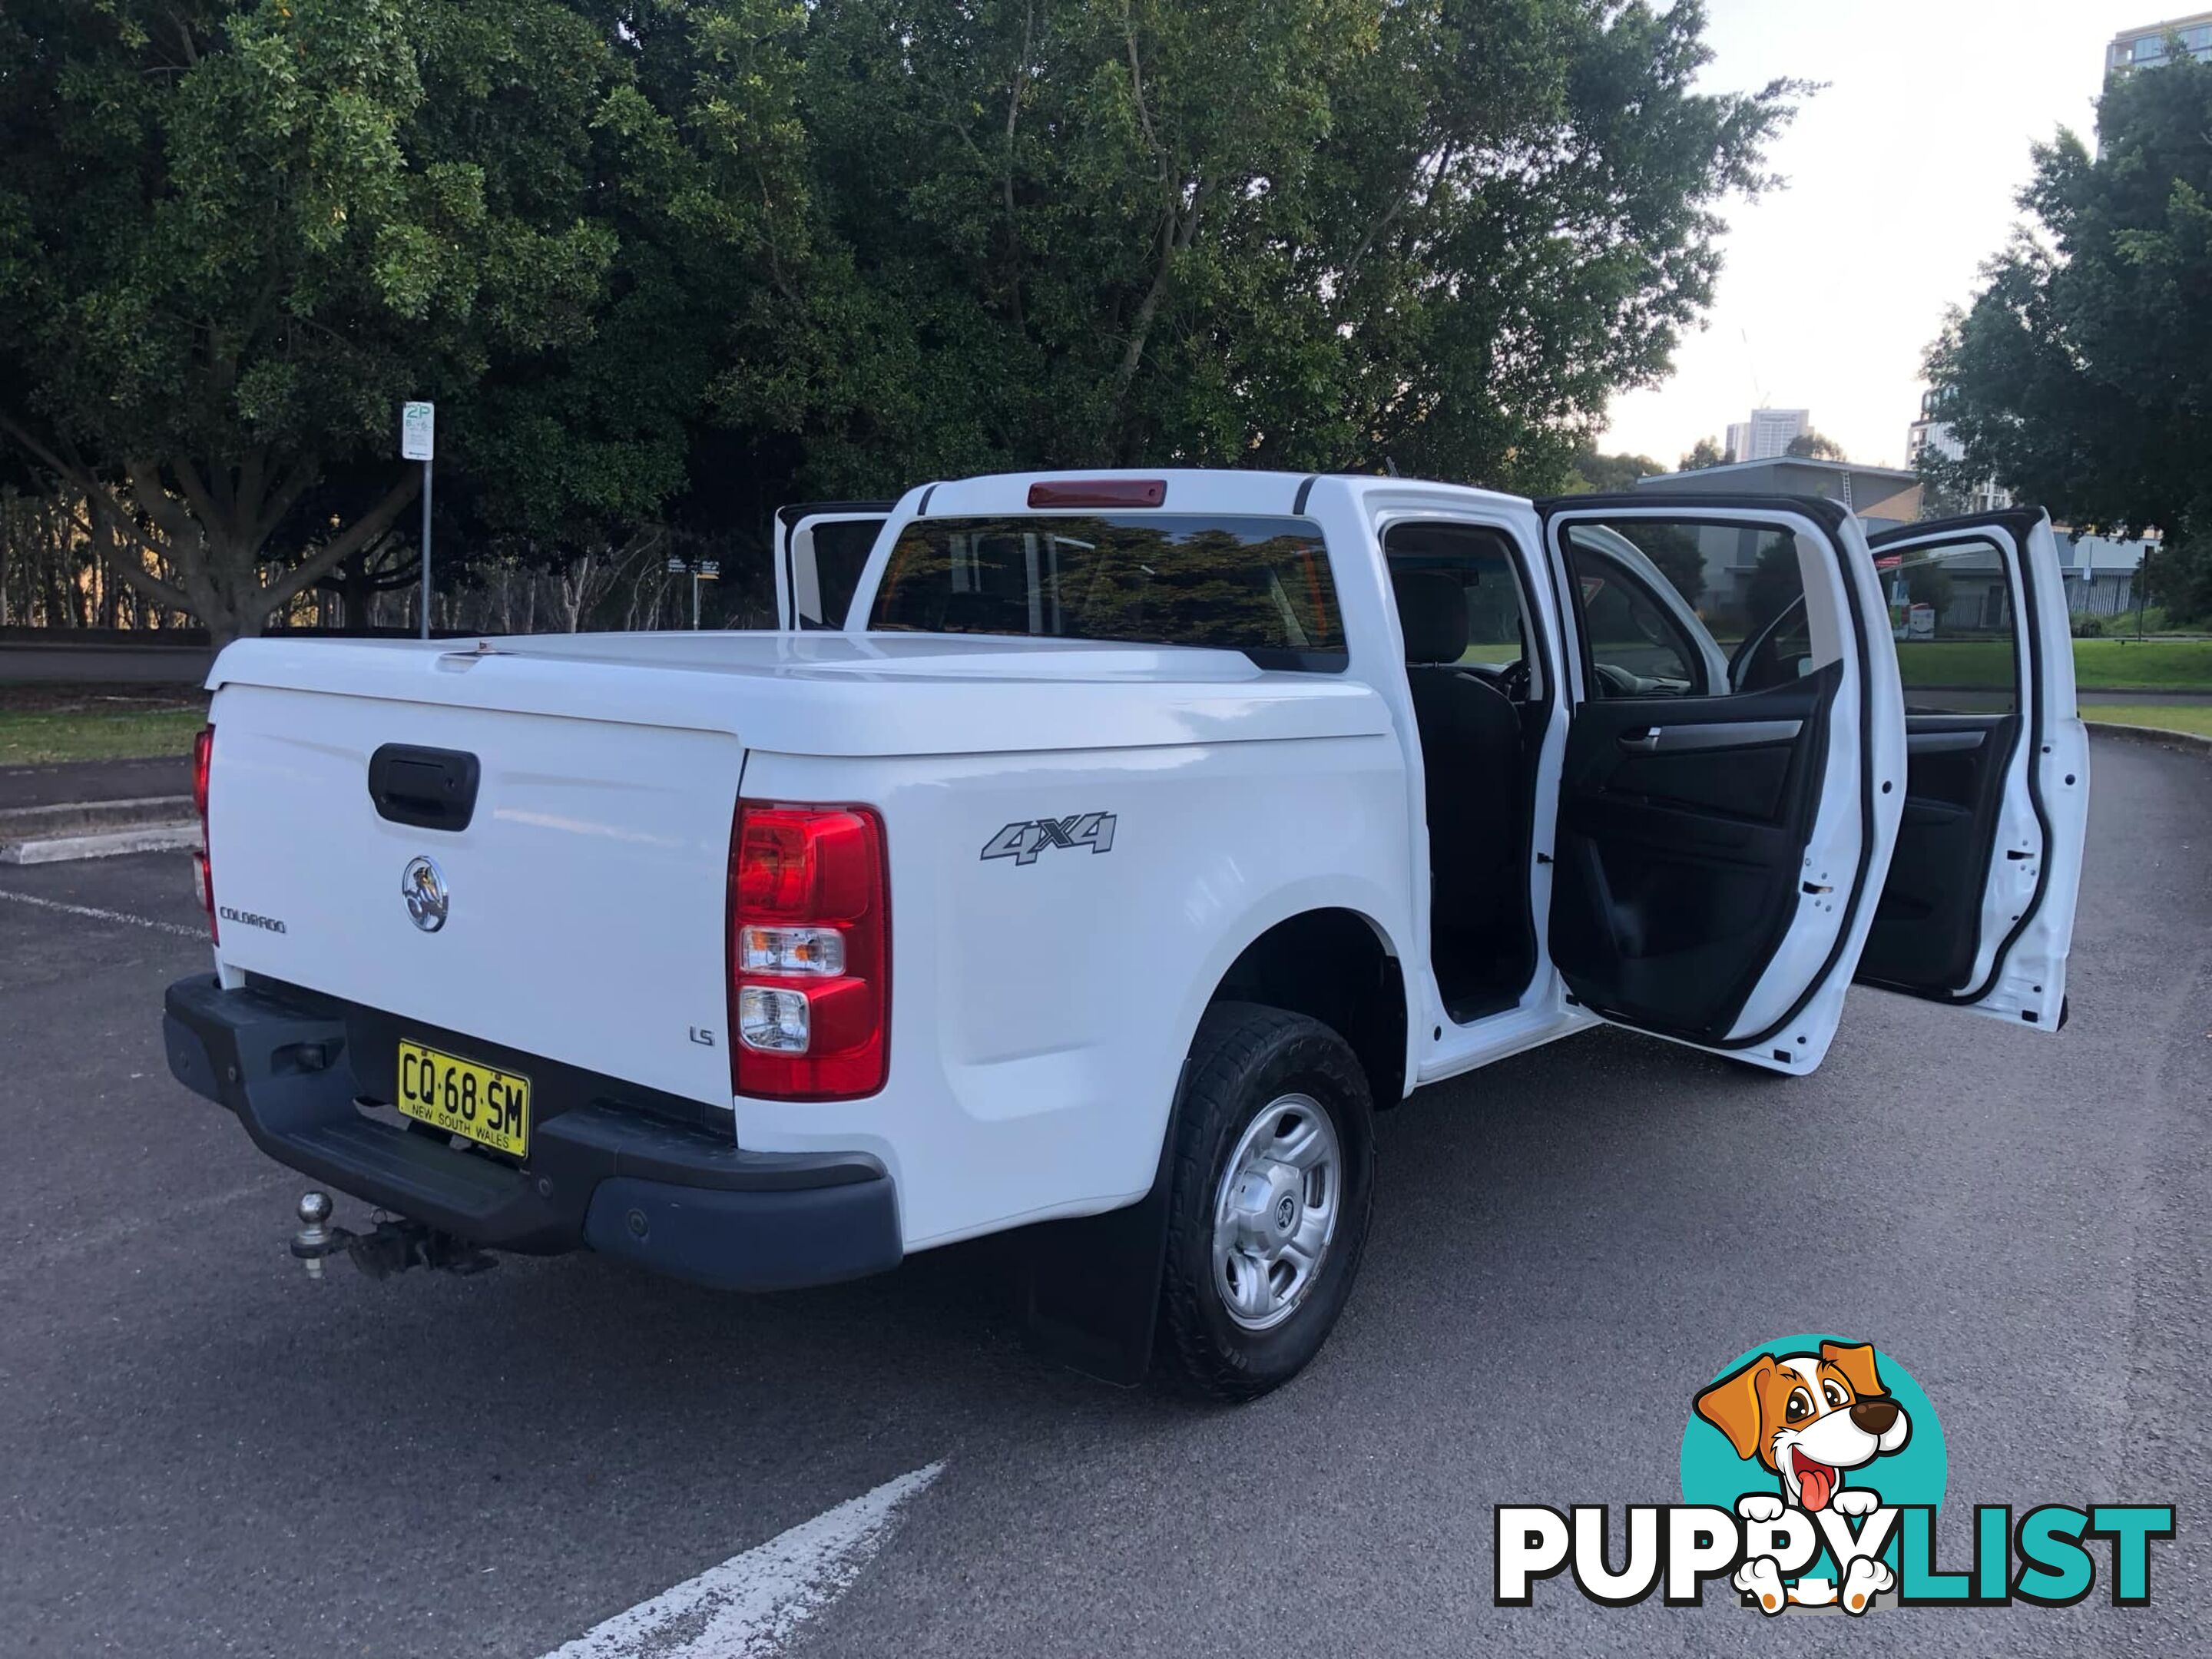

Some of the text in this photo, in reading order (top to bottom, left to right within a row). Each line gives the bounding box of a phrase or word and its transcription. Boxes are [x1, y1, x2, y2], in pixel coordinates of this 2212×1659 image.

[406, 406, 430, 419] 2P
[220, 906, 286, 934] COLORADO
[690, 1026, 714, 1046] LS
[412, 1104, 509, 1149] NEW SOUTH WALES
